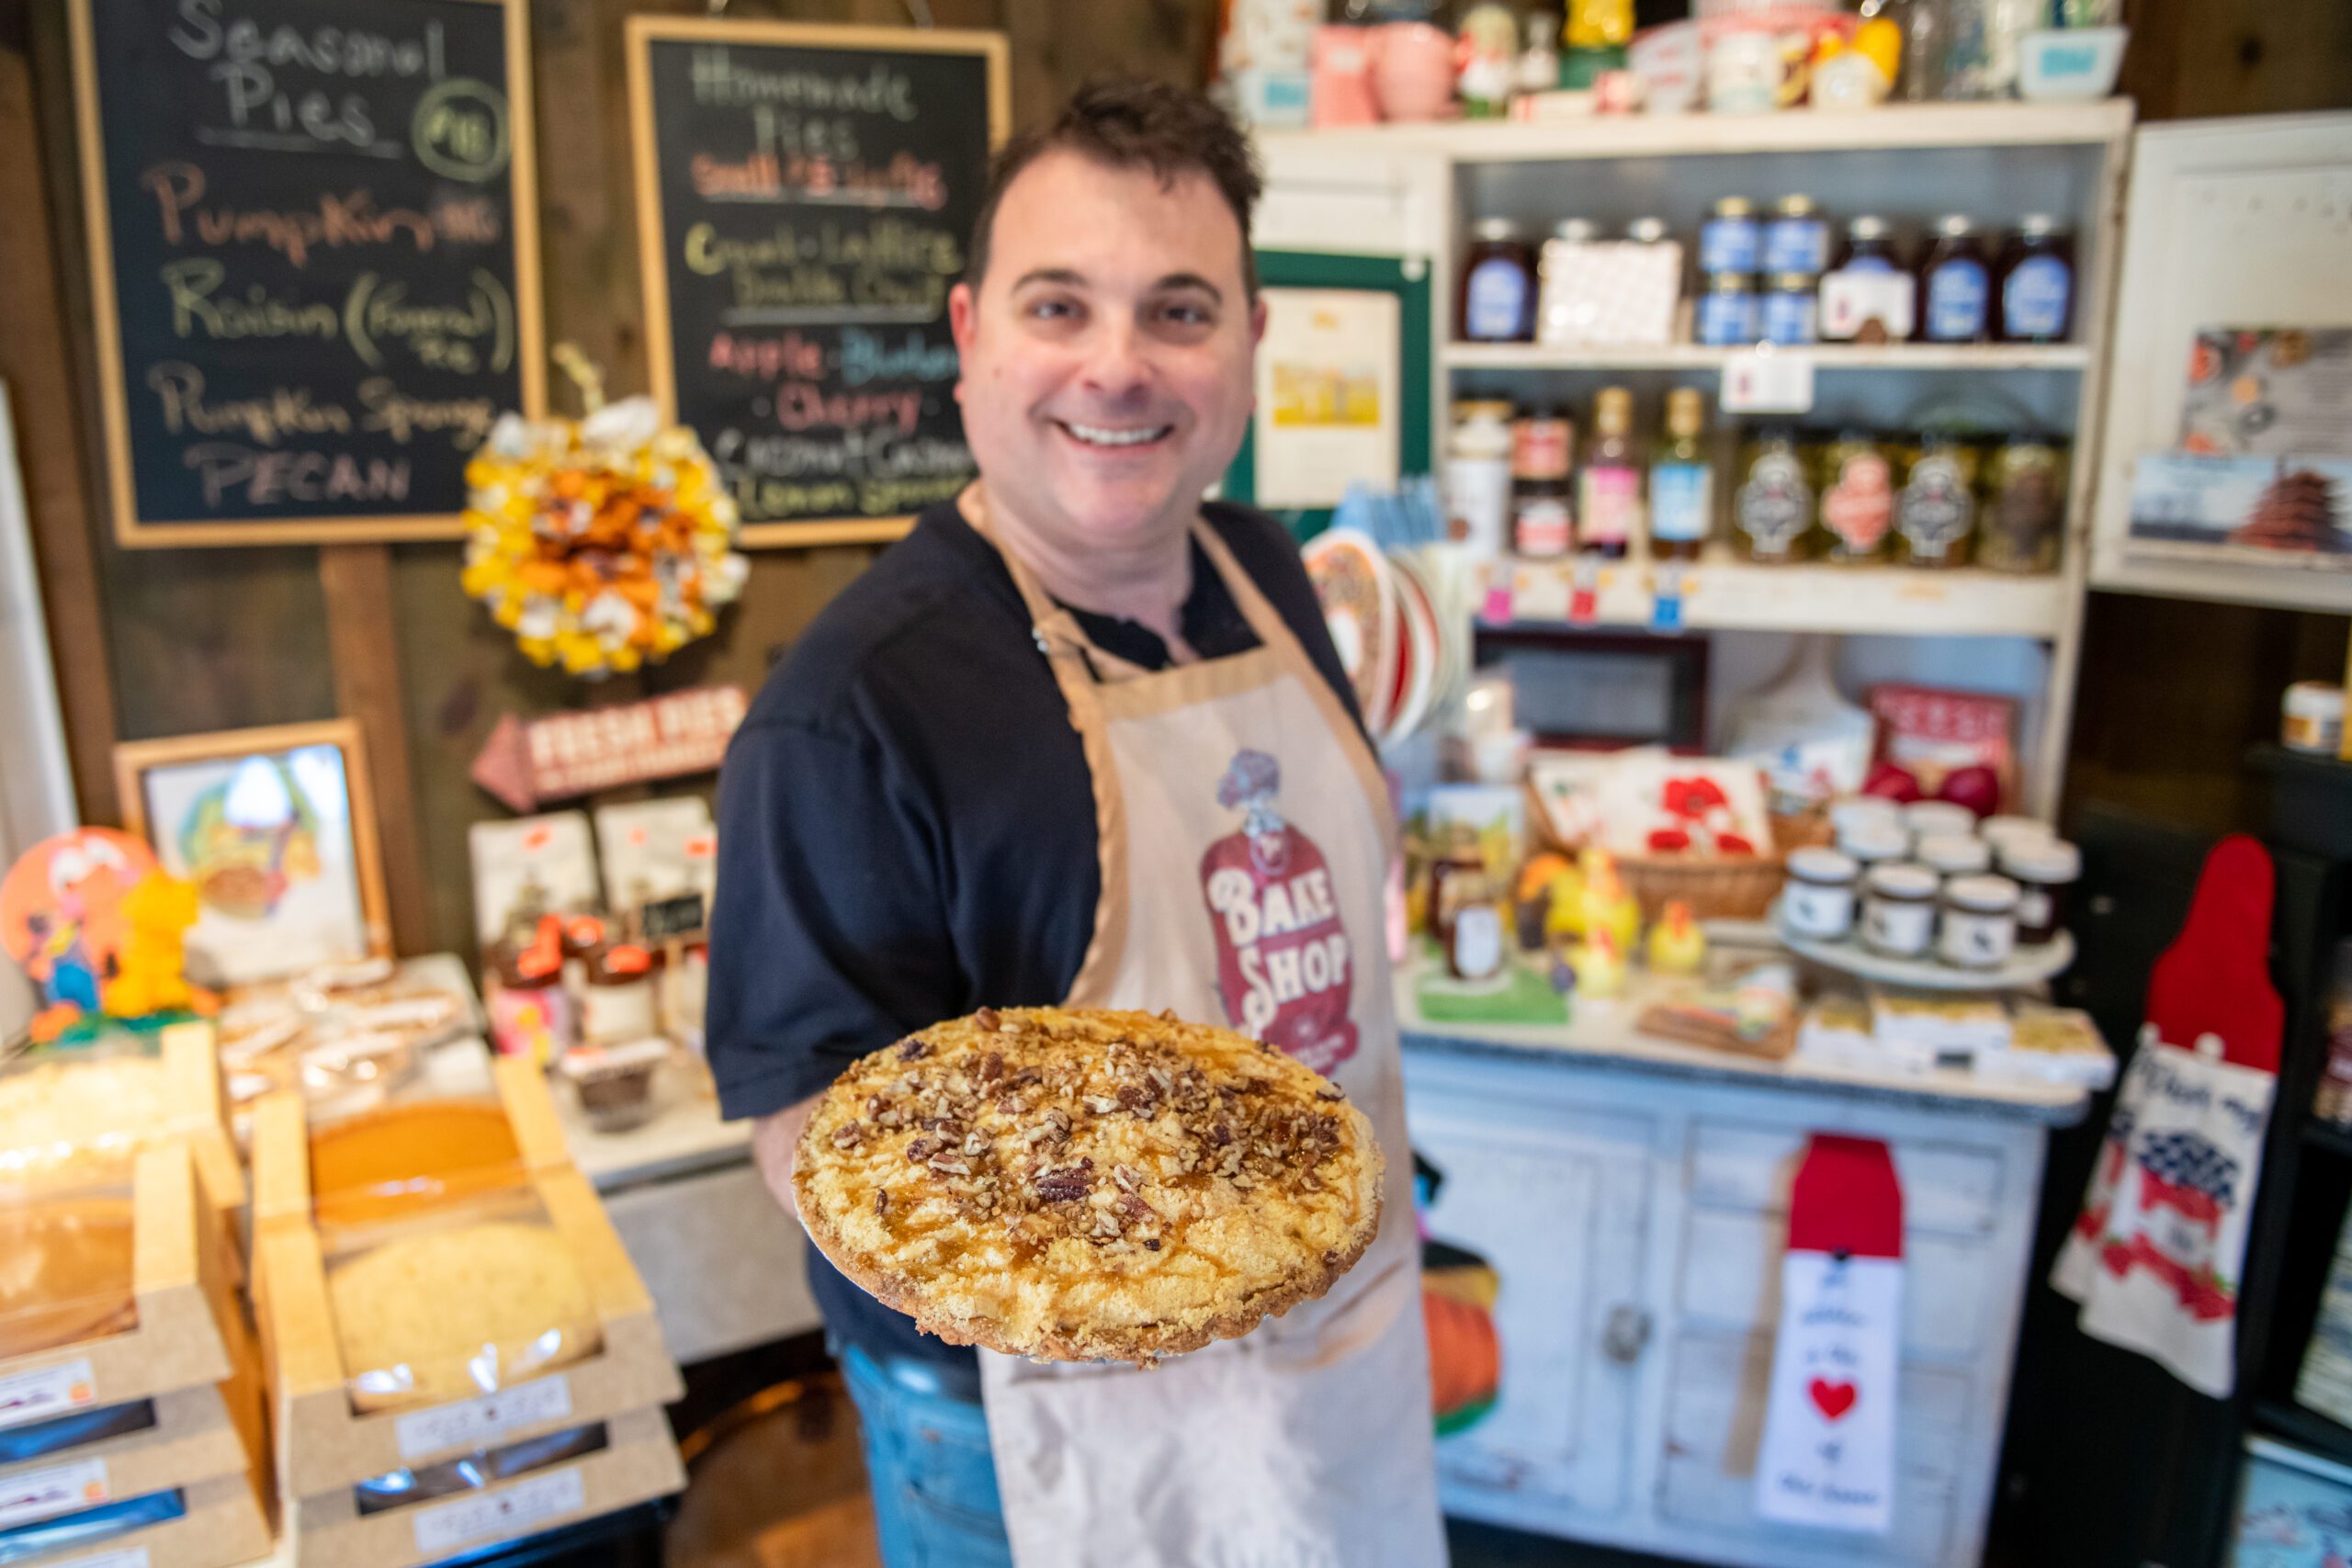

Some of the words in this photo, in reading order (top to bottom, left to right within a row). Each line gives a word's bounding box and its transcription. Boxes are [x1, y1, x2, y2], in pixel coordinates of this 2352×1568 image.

[208, 61, 377, 147] Pies
[140, 160, 436, 270] Pumpkin
[160, 256, 339, 341] Raisin
[708, 332, 827, 384] Apple
[145, 360, 353, 446] Pumpkin
[775, 380, 922, 439] Cherry
[184, 440, 413, 510] PECAN
[1207, 866, 1335, 948] BAKE
[1238, 933, 1348, 1033] SHOP
